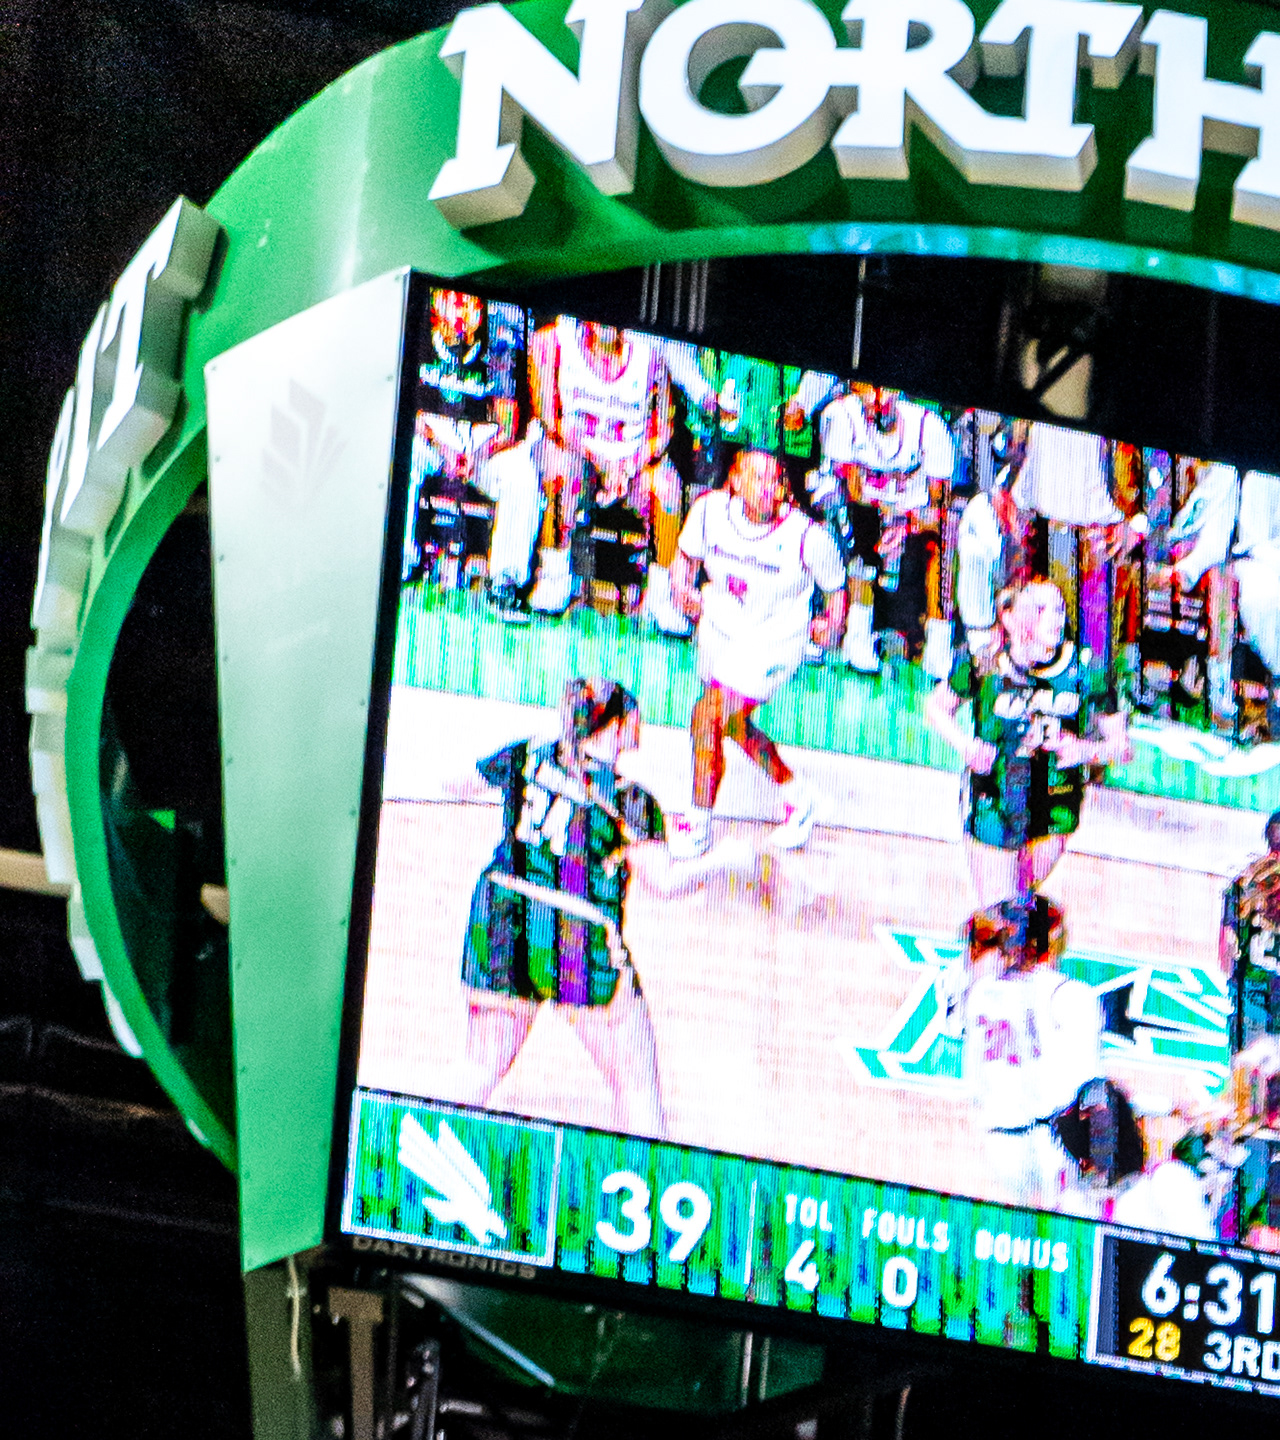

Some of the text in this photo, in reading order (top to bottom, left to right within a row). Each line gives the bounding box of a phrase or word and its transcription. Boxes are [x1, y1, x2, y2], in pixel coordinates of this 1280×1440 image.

[596, 1168, 712, 1263] 39
[785, 1193, 1070, 1272] TOL FOULS BONUS
[351, 1232, 538, 1281] DAKTRONICS
[784, 1243, 919, 1308] 4 0
[1141, 1250, 1279, 1334] 6:31
[1127, 1316, 1182, 1363] 28
